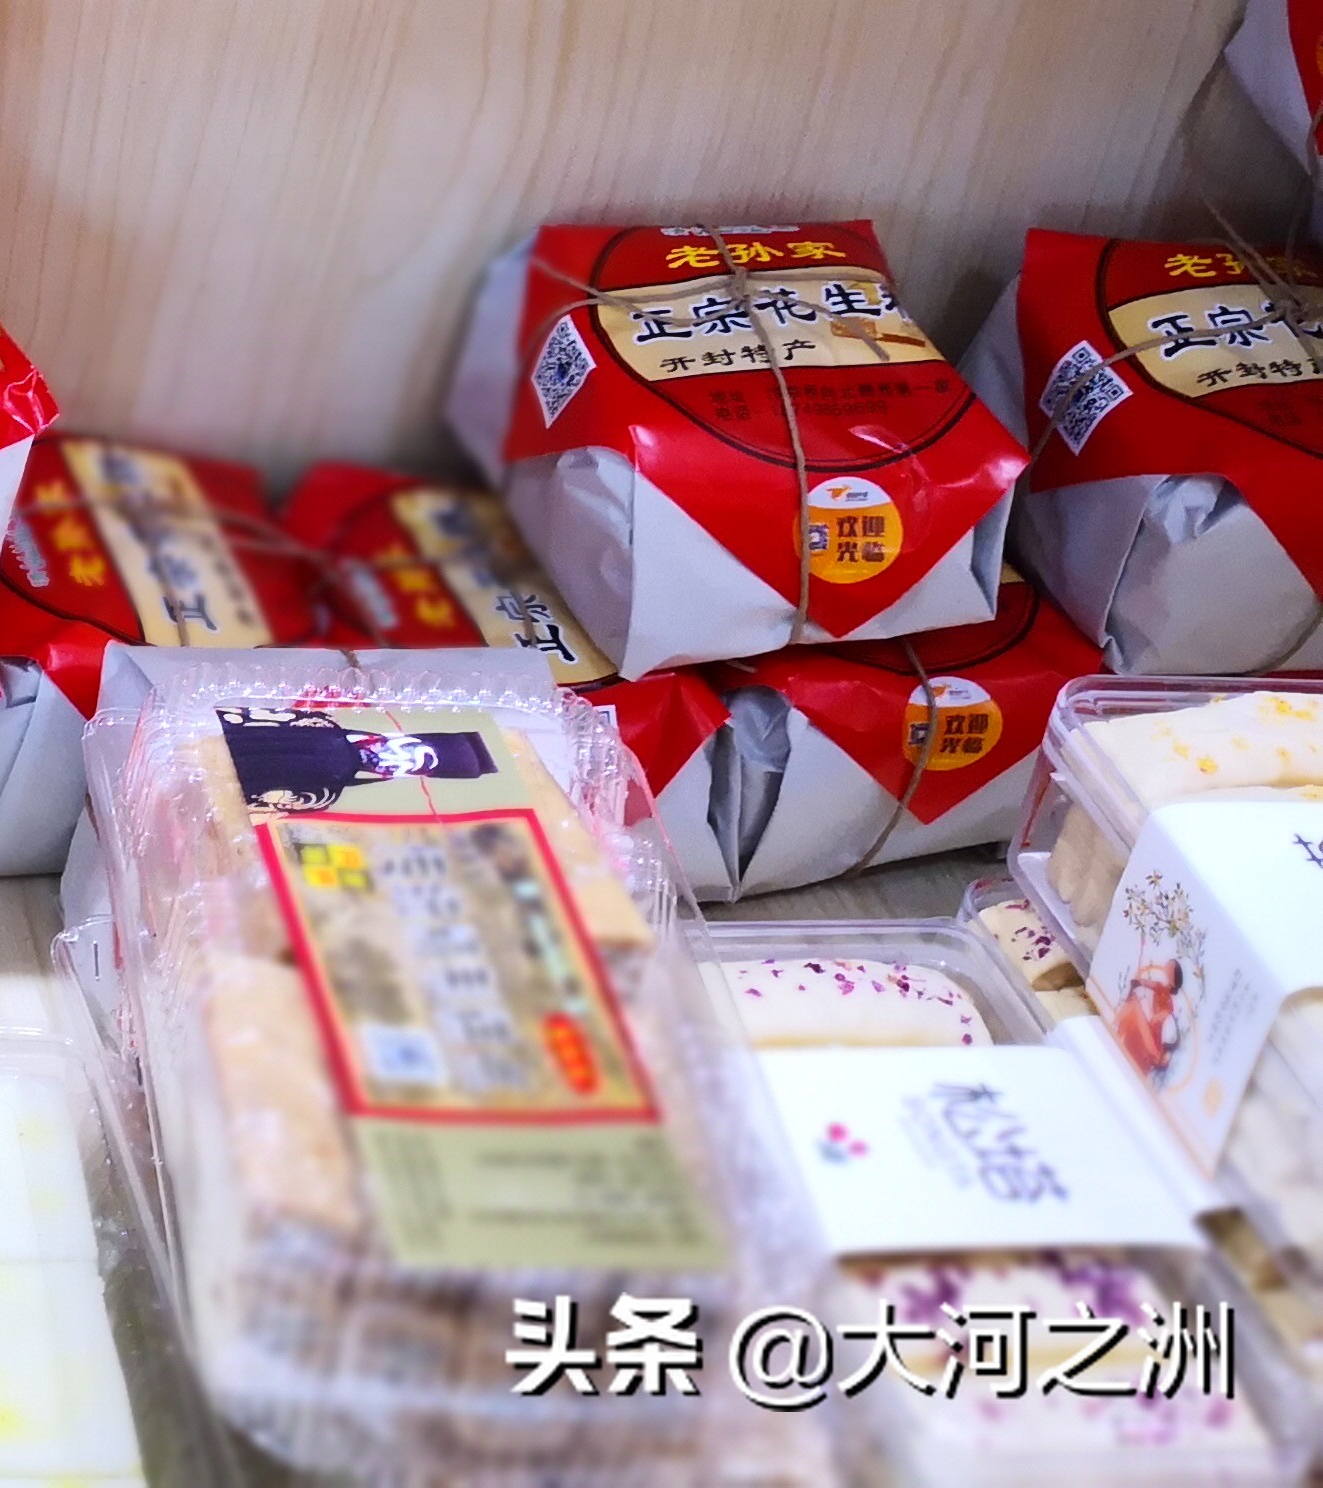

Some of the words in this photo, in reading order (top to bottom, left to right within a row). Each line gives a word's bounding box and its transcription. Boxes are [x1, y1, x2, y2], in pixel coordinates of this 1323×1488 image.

[665, 241, 846, 269] 老孙家
[660, 339, 816, 373] 开封特产
[837, 516, 885, 538] 欢迎
